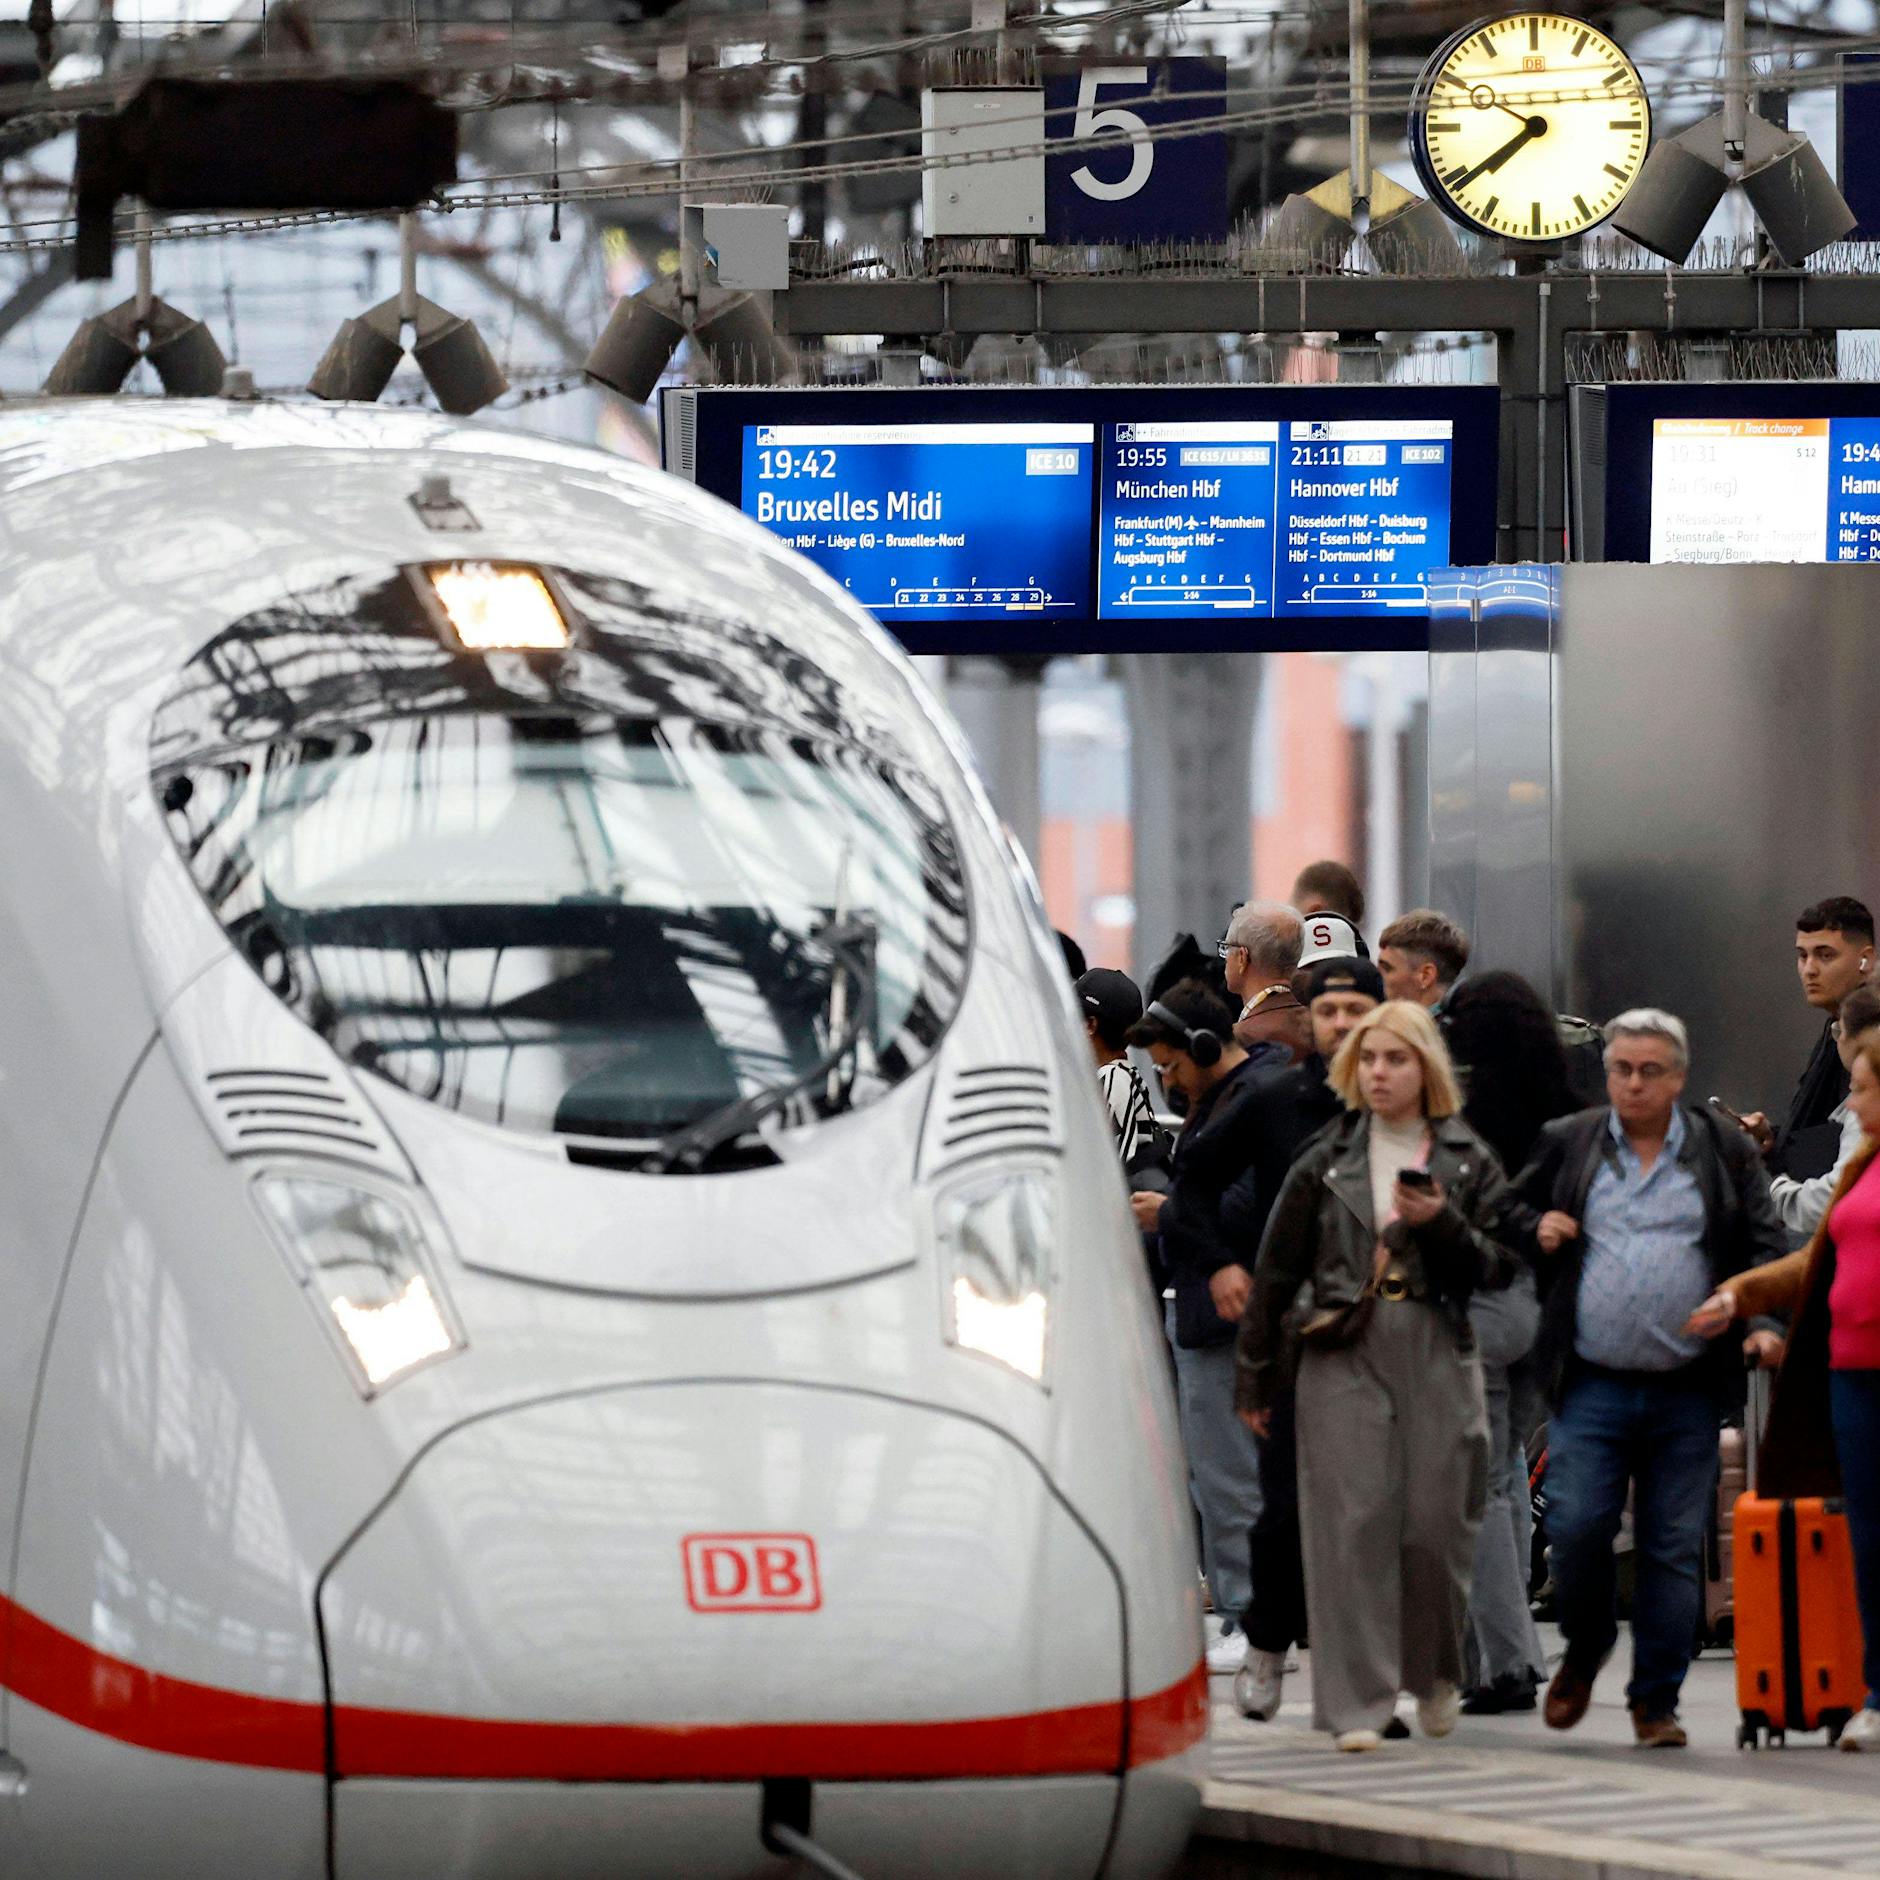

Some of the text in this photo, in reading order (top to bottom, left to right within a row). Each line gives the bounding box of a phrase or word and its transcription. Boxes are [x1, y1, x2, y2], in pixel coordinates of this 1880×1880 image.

[1526, 58, 1543, 69] DB
[1070, 66, 1154, 201] 5
[1744, 423, 1768, 434] Track
[1770, 423, 1804, 435] change
[1116, 448, 1167, 467] 19:55
[1184, 451, 1199, 462] ICE
[1291, 447, 1341, 466] 21:11
[1346, 449, 1382, 462] 2121
[1405, 449, 1441, 460] ICE 102
[1796, 448, 1816, 458] S 12
[758, 450, 836, 479] 19:42
[1030, 454, 1075, 470] ICE 10
[1116, 479, 1221, 498] München Hbf
[1290, 477, 1399, 497] Hannover Hbf
[1841, 475, 1880, 494] Ham
[758, 491, 941, 522] Bruxelles Midi
[1210, 516, 1265, 529] Mannheim
[1289, 514, 1347, 528] Düsseldorf
[1349, 514, 1369, 527] Hbf
[1379, 514, 1427, 530] Duisburg
[1840, 512, 1848, 524] K
[797, 534, 816, 547] Hbf
[828, 534, 856, 550] Liège
[859, 533, 874, 549] (G)
[886, 533, 965, 547] Bruxelles-Nord
[1114, 534, 1134, 547] Hbf
[1145, 534, 1194, 549] Stuttgart
[1195, 533, 1215, 546] Hbf
[1289, 533, 1309, 546] Hbf
[1320, 532, 1350, 545] Essen
[1352, 532, 1372, 545] Hbf
[1383, 531, 1426, 544] Bochum
[1665, 530, 1725, 543] Steinstraße
[1840, 529, 1859, 542] Hbf
[1113, 551, 1186, 567] Augsburg Hbf
[1289, 550, 1308, 562] Hbf
[1320, 549, 1372, 562] Dortmund
[1375, 549, 1395, 562] Hbf
[1839, 546, 1859, 559] Hbf
[845, 576, 1035, 587] C D E F G
[1130, 575, 1251, 584] A B C D E F G
[1303, 573, 1424, 582] A B C D E F G
[919, 593, 929, 603] 22
[955, 593, 965, 602] 24
[974, 593, 983, 602] 25
[1029, 592, 1039, 602] 29
[1313, 924, 1331, 946] S
[702, 1547, 802, 1596] DB
